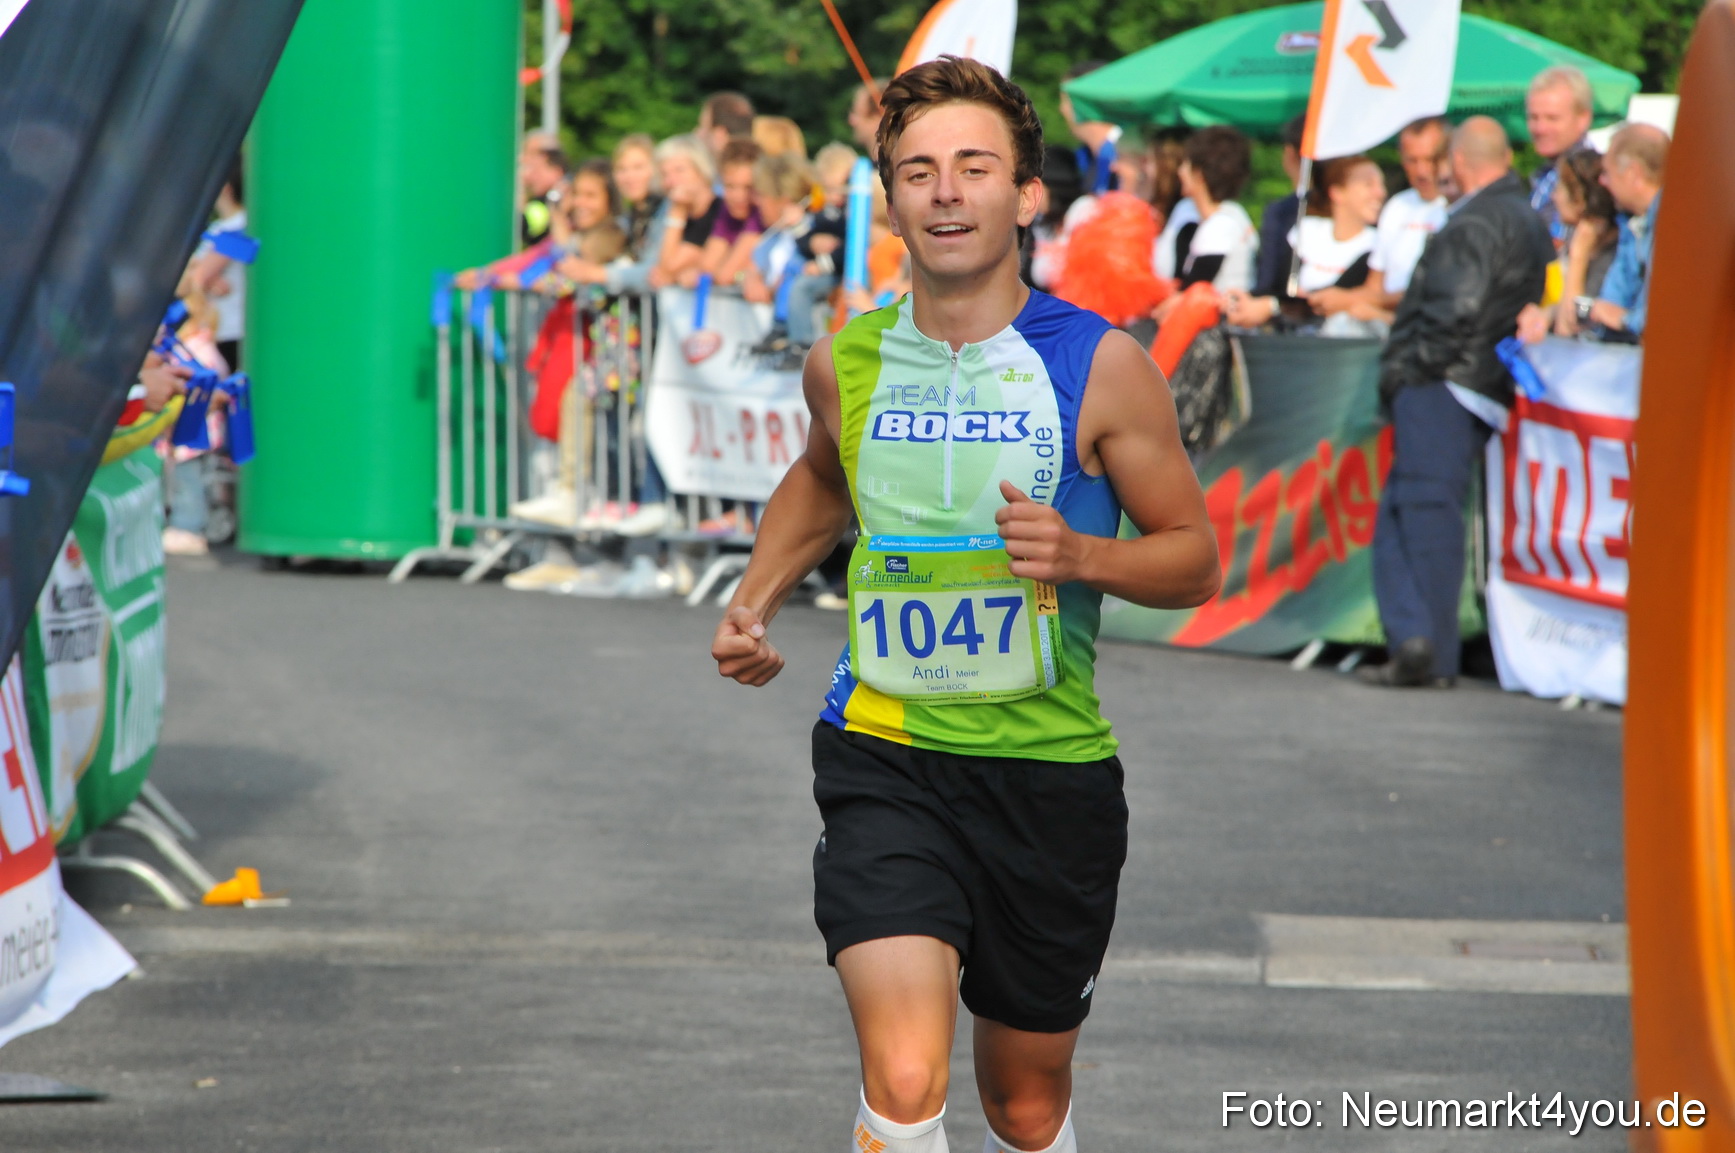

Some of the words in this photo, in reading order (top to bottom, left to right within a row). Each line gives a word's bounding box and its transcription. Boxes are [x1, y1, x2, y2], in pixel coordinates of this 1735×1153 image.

[887, 384, 977, 407] TEAM
[871, 410, 1031, 443] BOCK
[873, 571, 934, 584] firmenlauf
[860, 595, 1023, 659] 1047
[912, 665, 950, 679] Andi
[955, 669, 979, 678] Meier
[946, 682, 968, 691] BOCK
